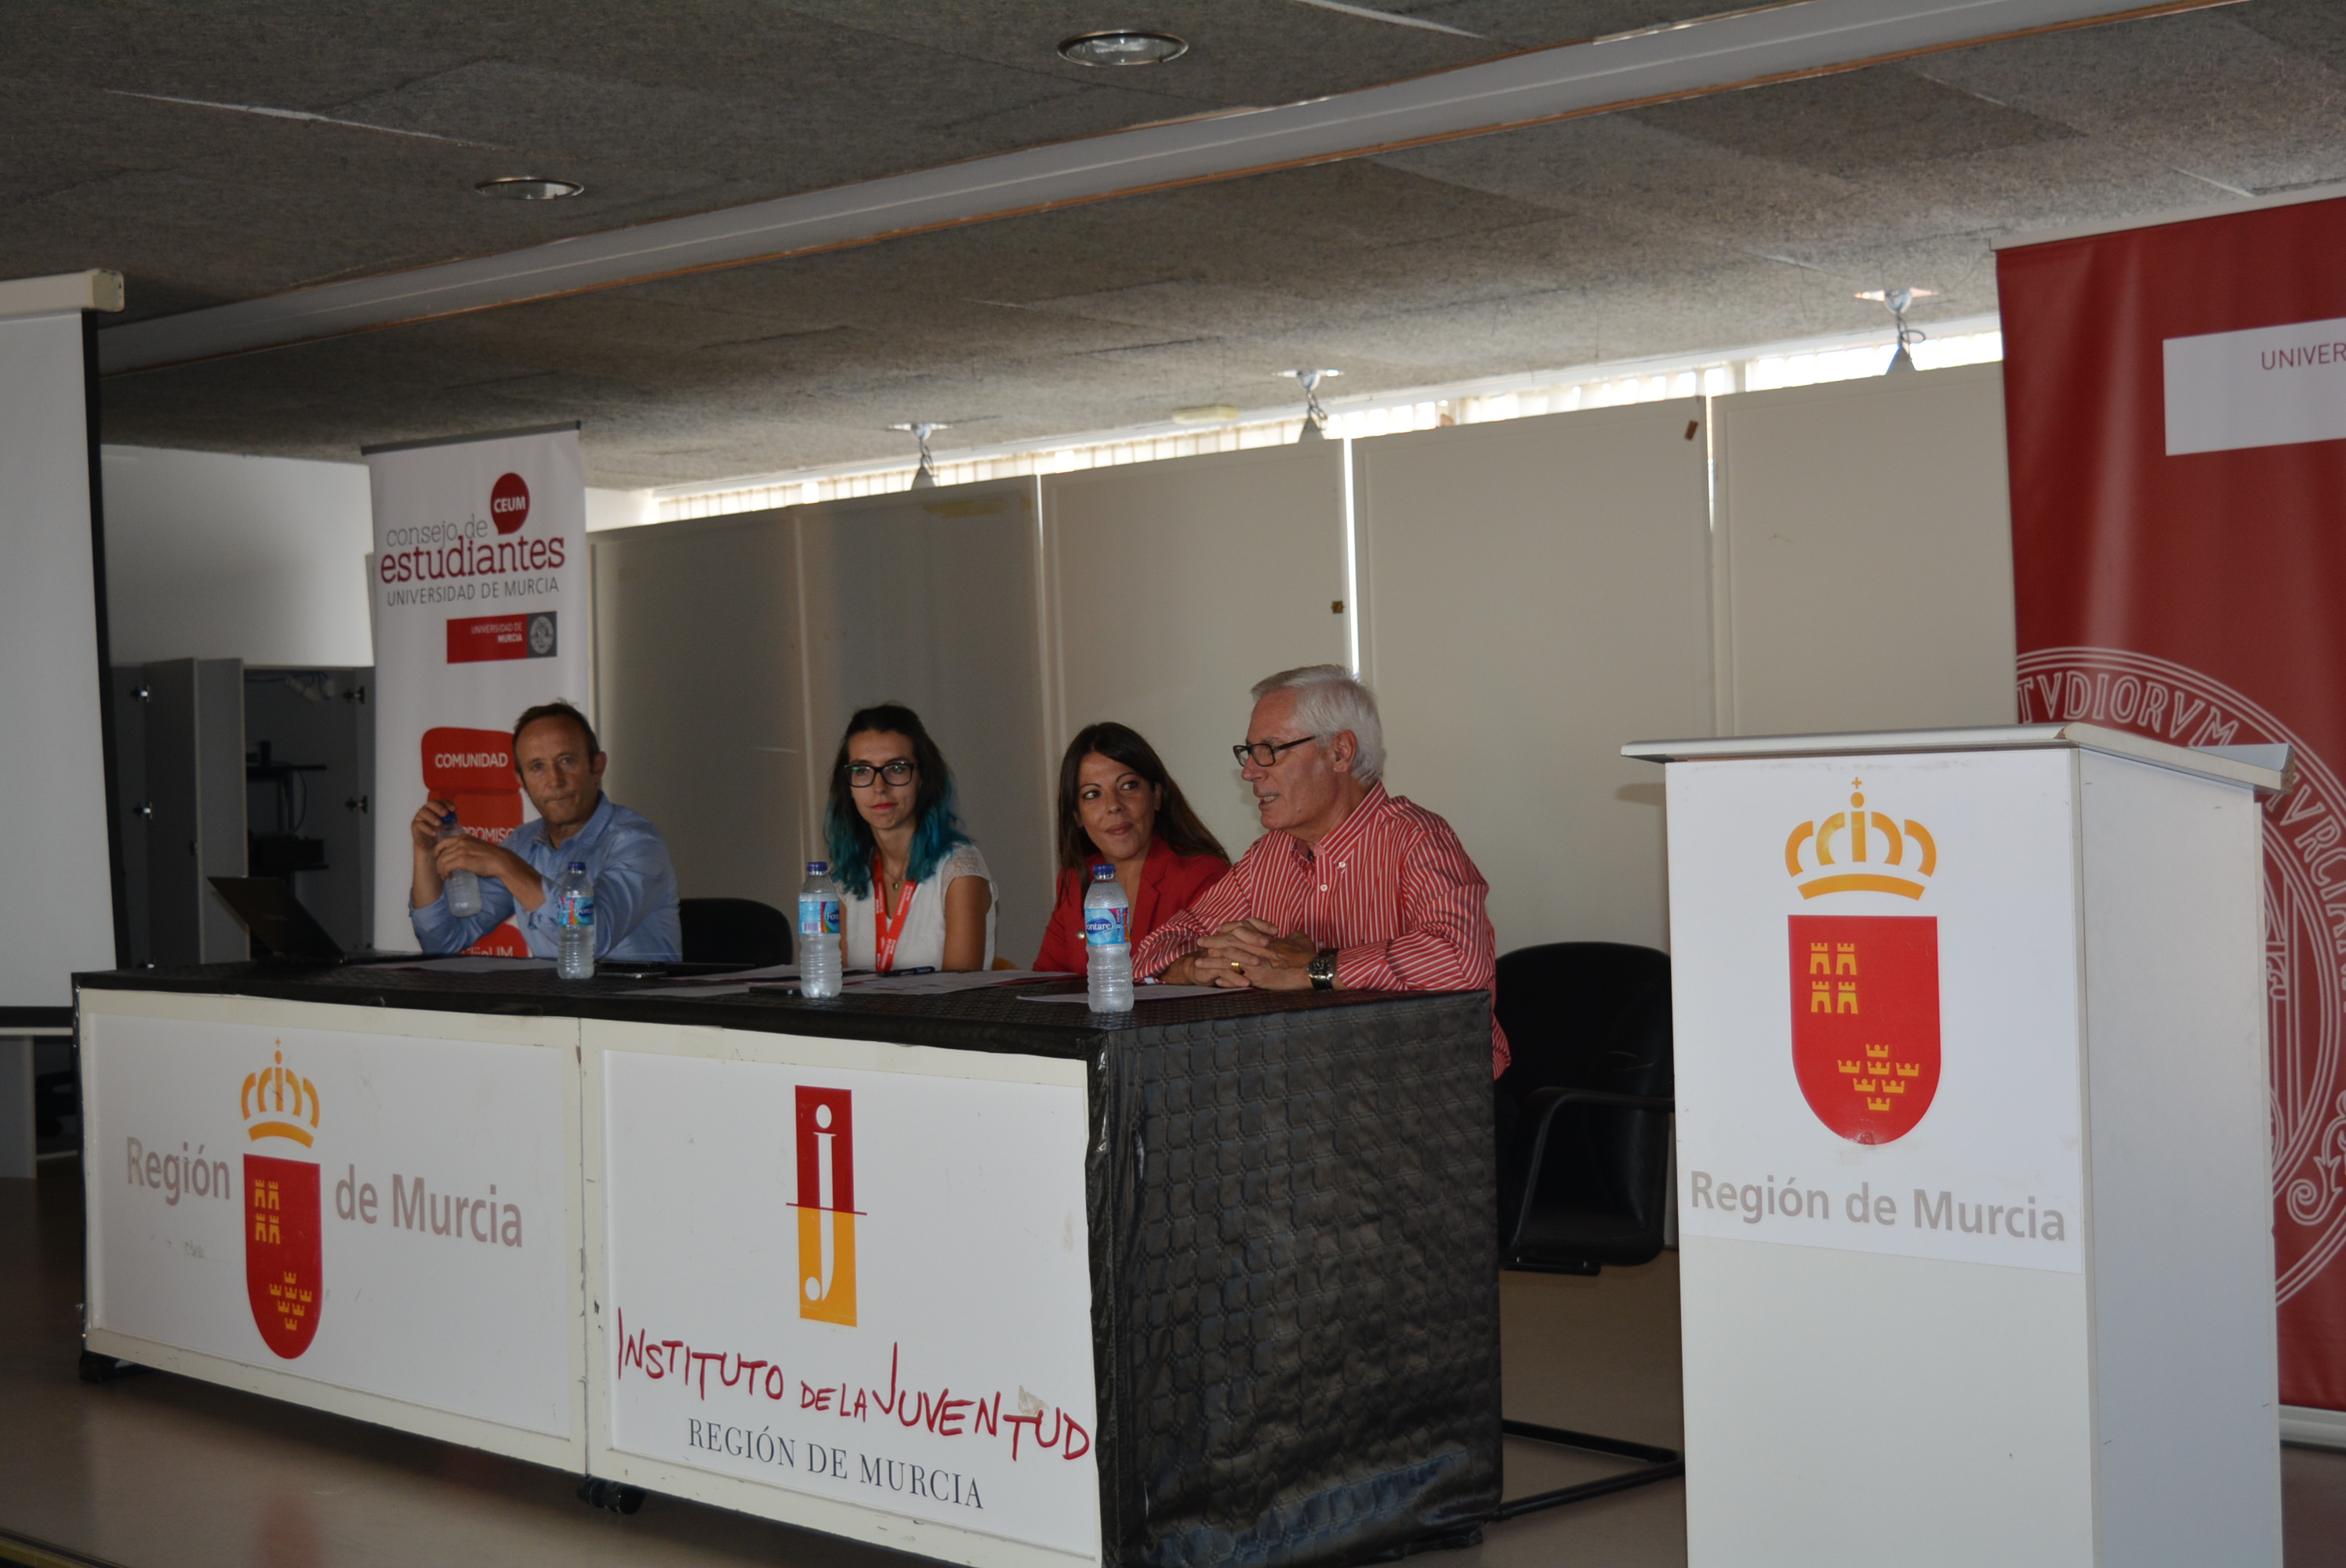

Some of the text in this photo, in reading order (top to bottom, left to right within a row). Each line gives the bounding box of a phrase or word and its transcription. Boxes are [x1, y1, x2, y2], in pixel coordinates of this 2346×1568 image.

[2261, 342, 2346, 371] UNIVER
[493, 496, 526, 514] CEUM
[386, 514, 488, 550] consejo de
[380, 535, 566, 584] estudiantes
[387, 576, 560, 607] UNIVERSIDAD DE MURCIA
[497, 633, 523, 643] MURCIA
[434, 753, 508, 769] COMUNIDAD
[126, 1136, 523, 1248] Región de Murcia
[1690, 1170, 2065, 1242] Región de Murcia
[617, 1307, 784, 1401] INSTITUTO
[872, 1341, 1091, 1461] JUVENTUD
[688, 1417, 985, 1510] REGIÓN DE MURCIA
